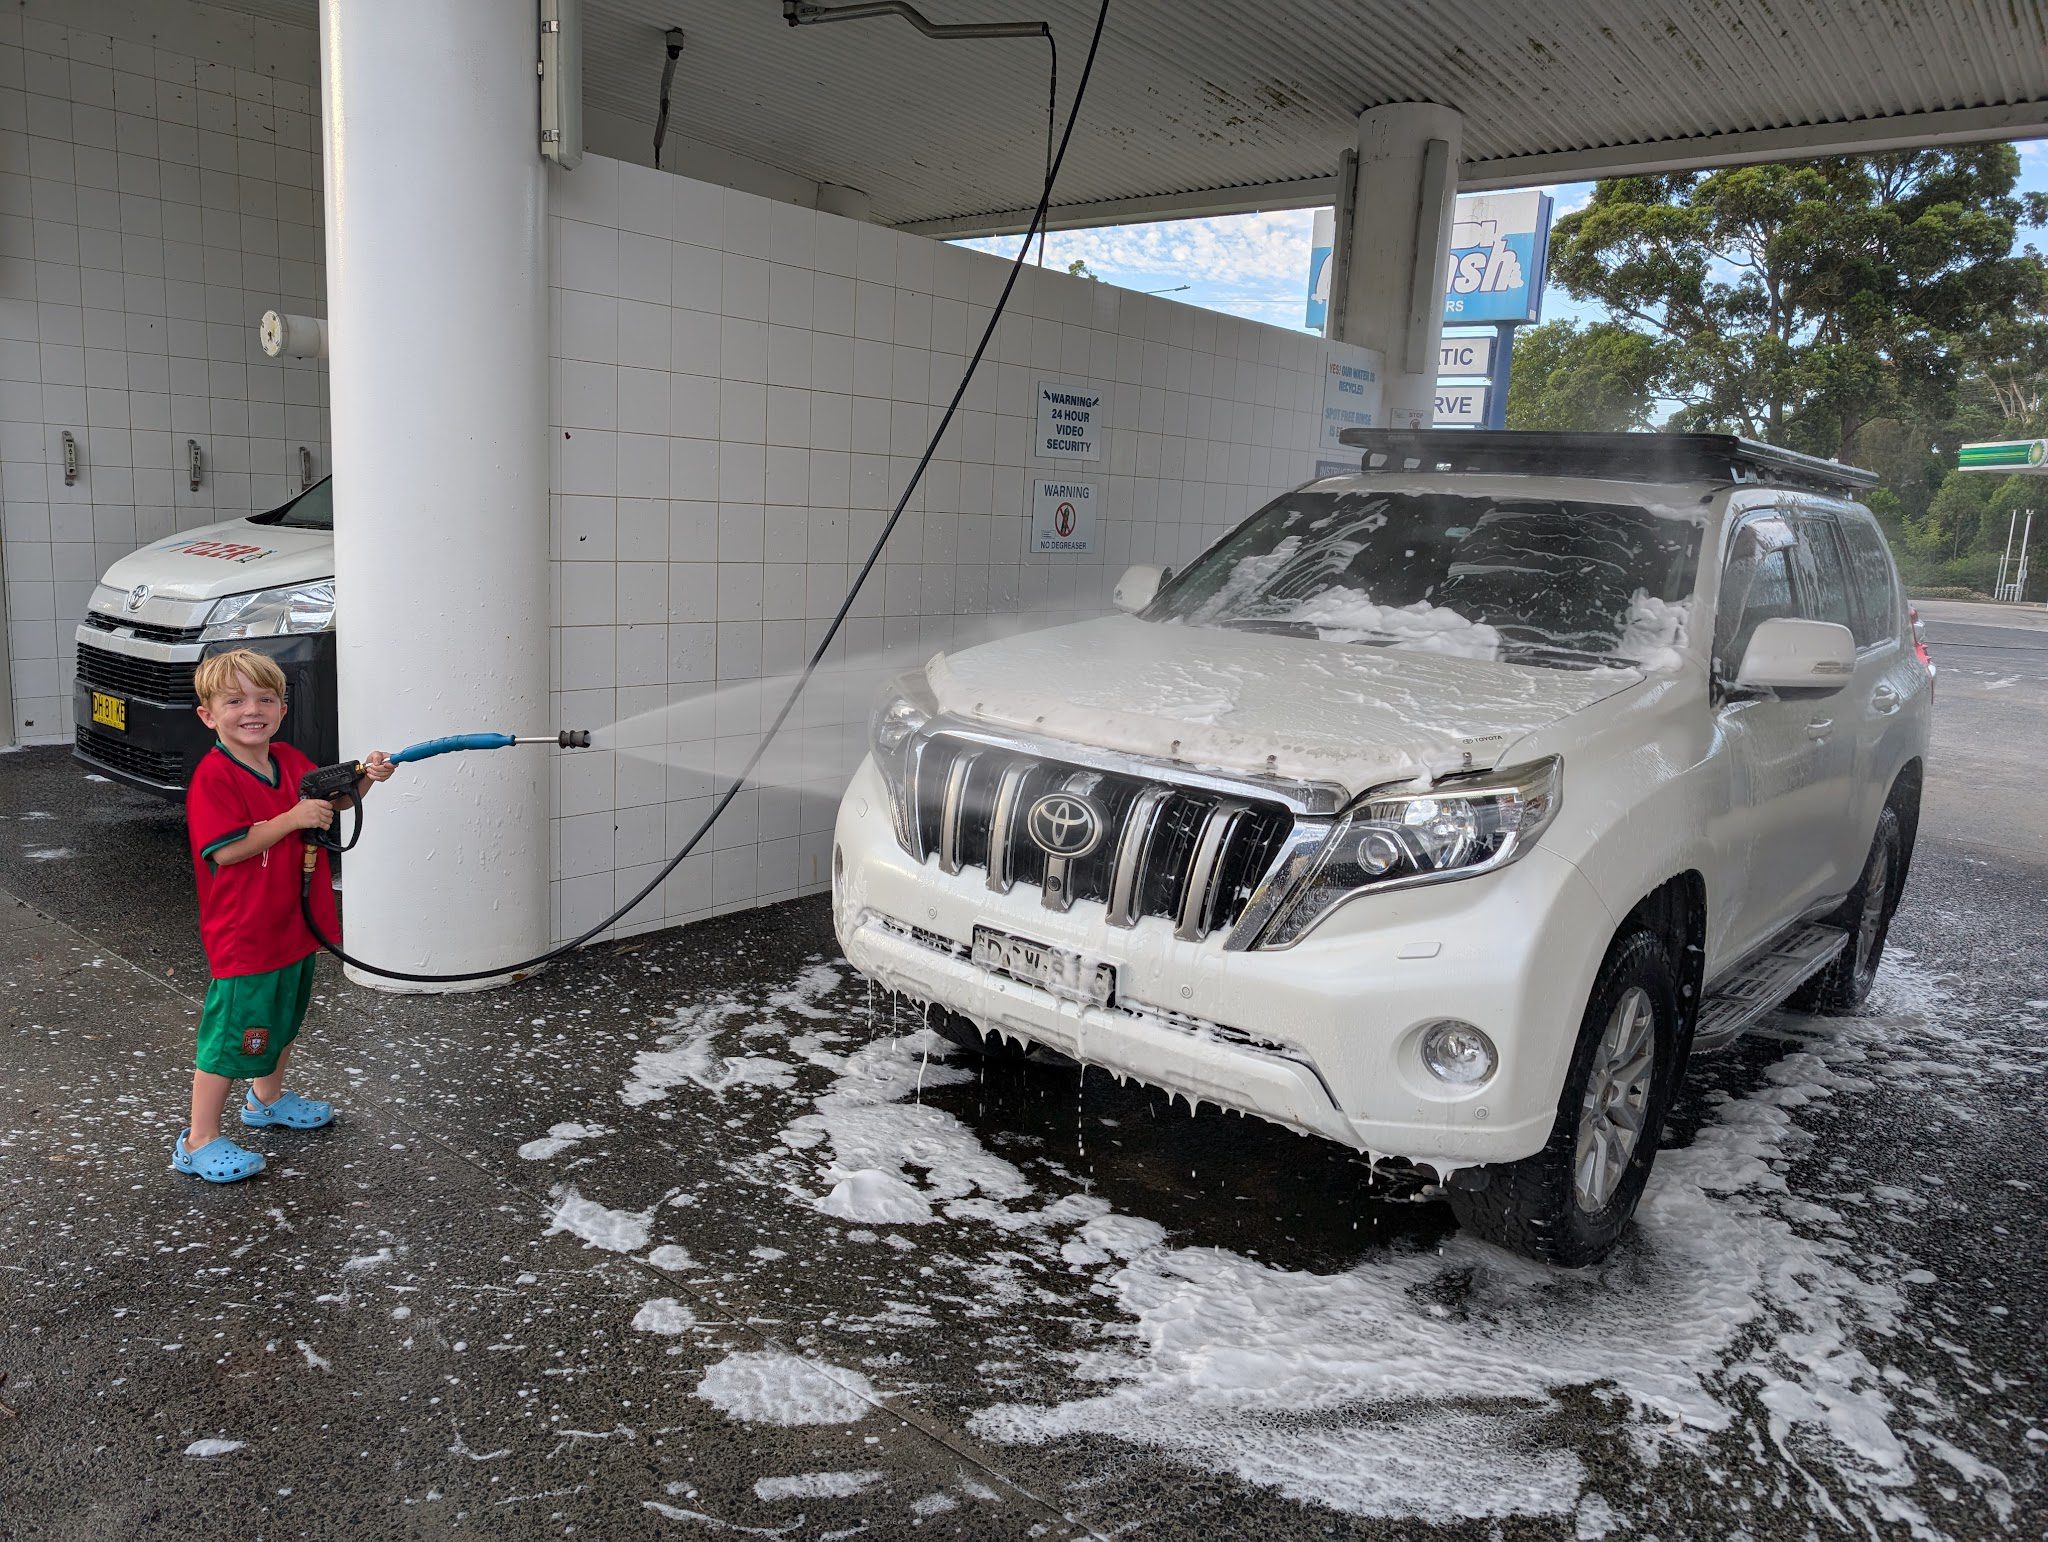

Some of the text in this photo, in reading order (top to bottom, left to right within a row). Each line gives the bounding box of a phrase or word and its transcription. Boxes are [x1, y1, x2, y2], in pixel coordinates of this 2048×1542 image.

[1445, 300, 1465, 312] RS
[1438, 347, 1474, 366] TIC
[1051, 392, 1092, 408] WARNING
[1434, 396, 1473, 414] RVE
[1051, 408, 1090, 423] 24 HOUR
[1055, 423, 1084, 437] VIDEO
[1046, 438, 1092, 453] SECURITY
[1044, 484, 1090, 499] WARNING
[1040, 540, 1087, 550] NO DEGREASER
